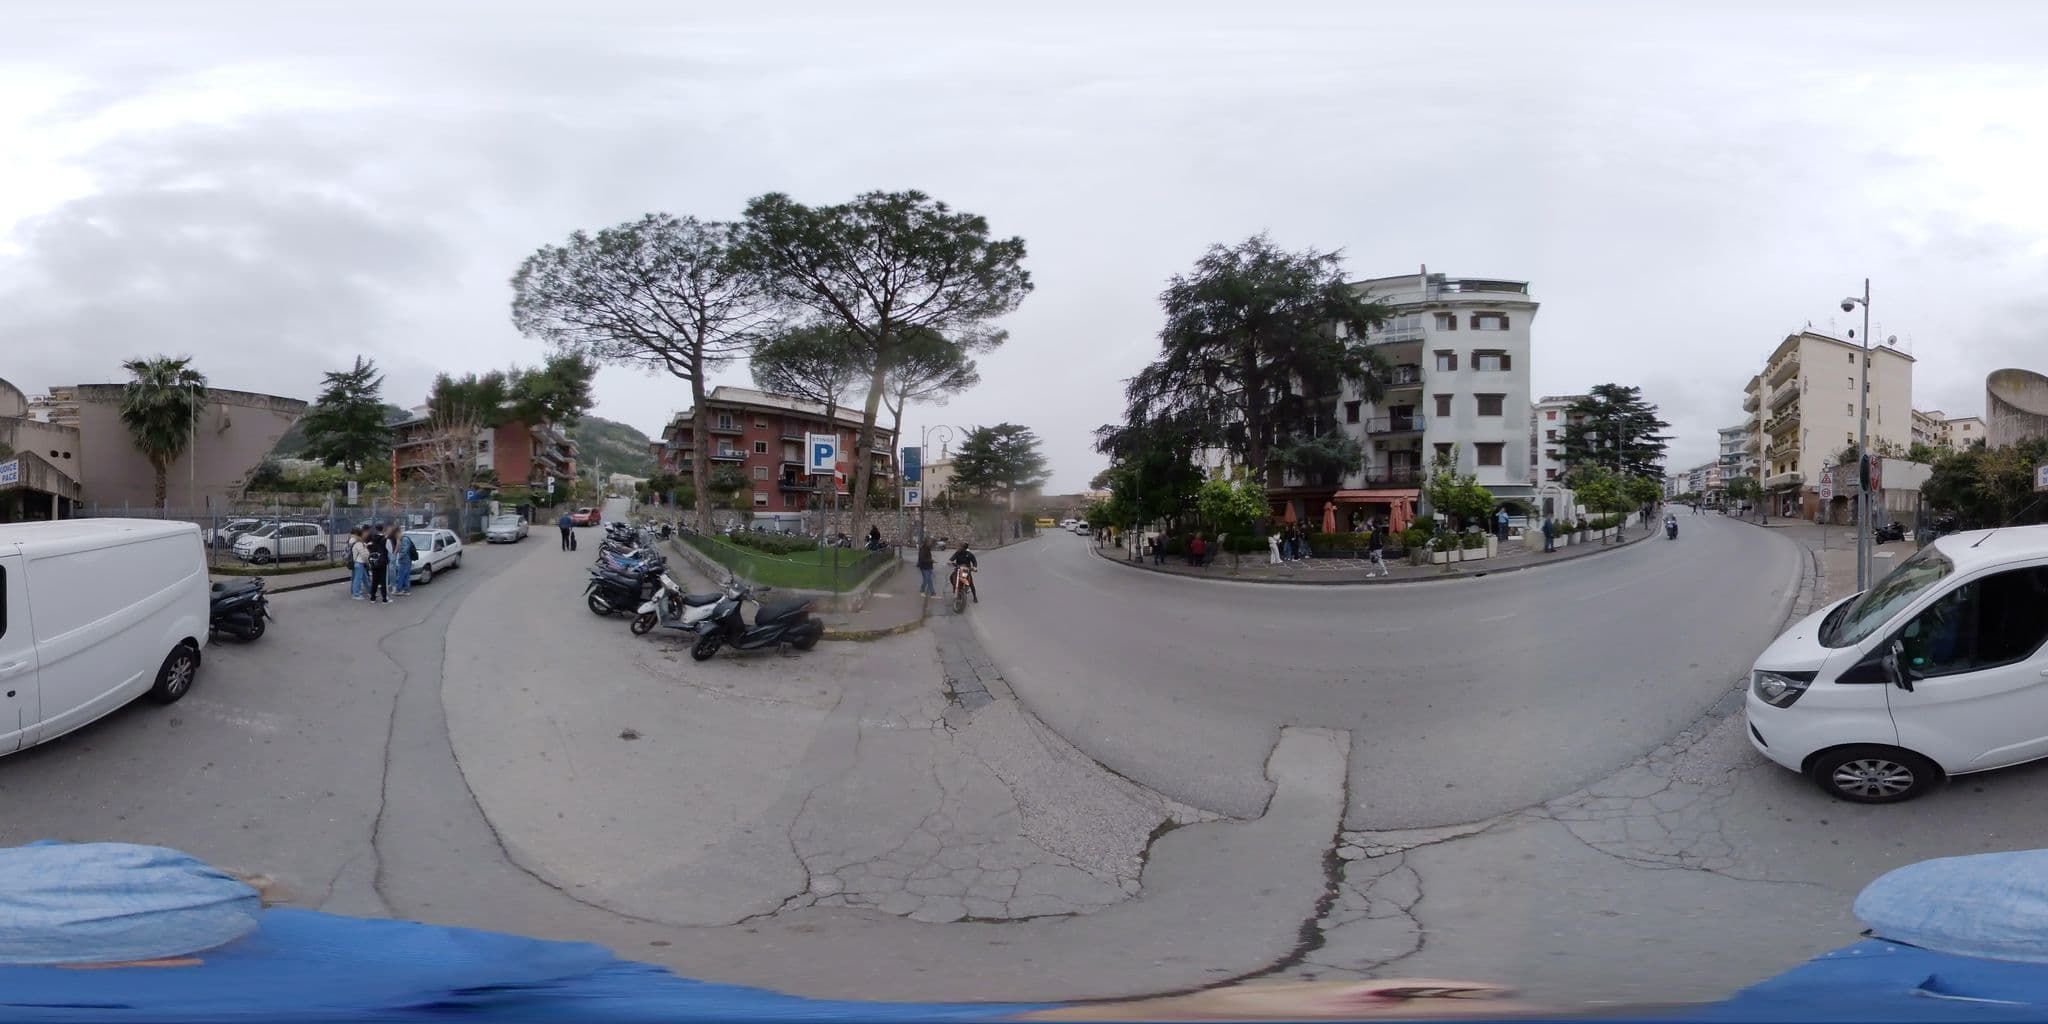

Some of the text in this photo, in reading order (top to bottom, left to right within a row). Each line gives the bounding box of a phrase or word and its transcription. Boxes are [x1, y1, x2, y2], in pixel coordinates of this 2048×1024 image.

[815, 443, 834, 466] P
[547, 476, 555, 486] P
[467, 490, 474, 500] P
[908, 491, 918, 502] P
